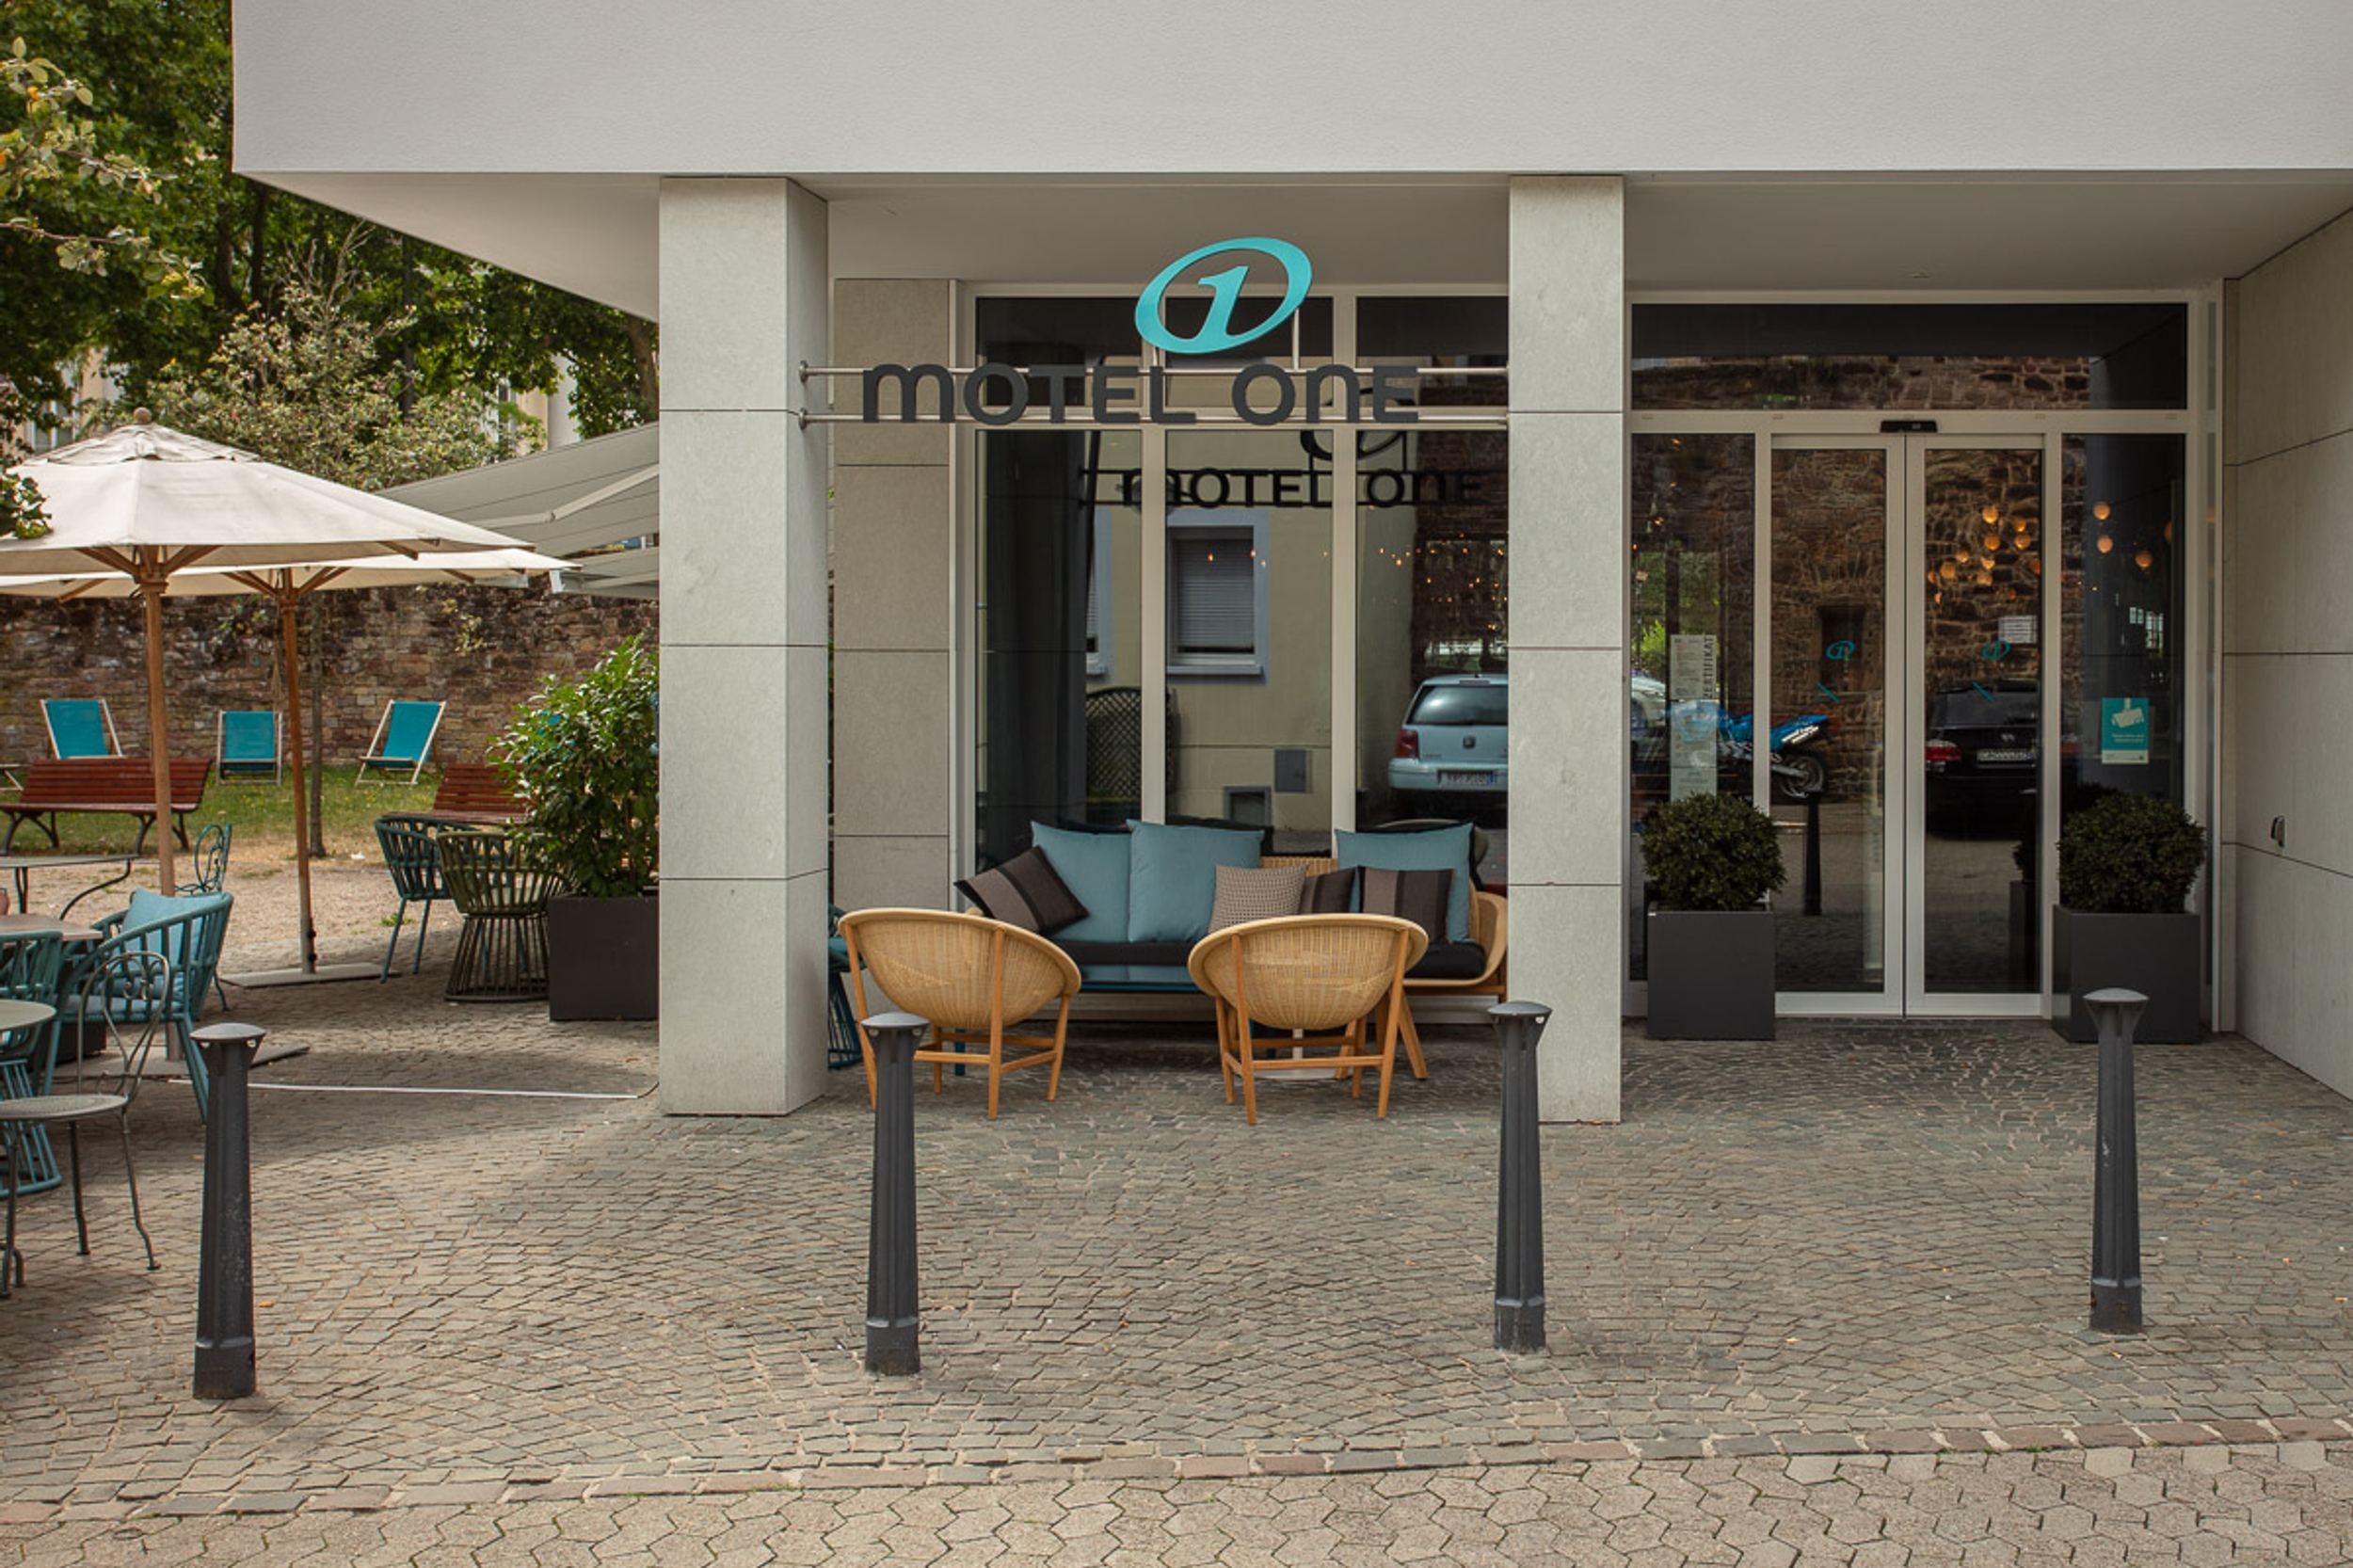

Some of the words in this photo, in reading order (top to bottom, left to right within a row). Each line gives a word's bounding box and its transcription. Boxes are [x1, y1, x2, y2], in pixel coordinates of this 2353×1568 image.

[862, 362, 1196, 425] MOTEL
[1232, 362, 1419, 425] ONE
[1703, 637, 1715, 699] ZERTIFIKAT
